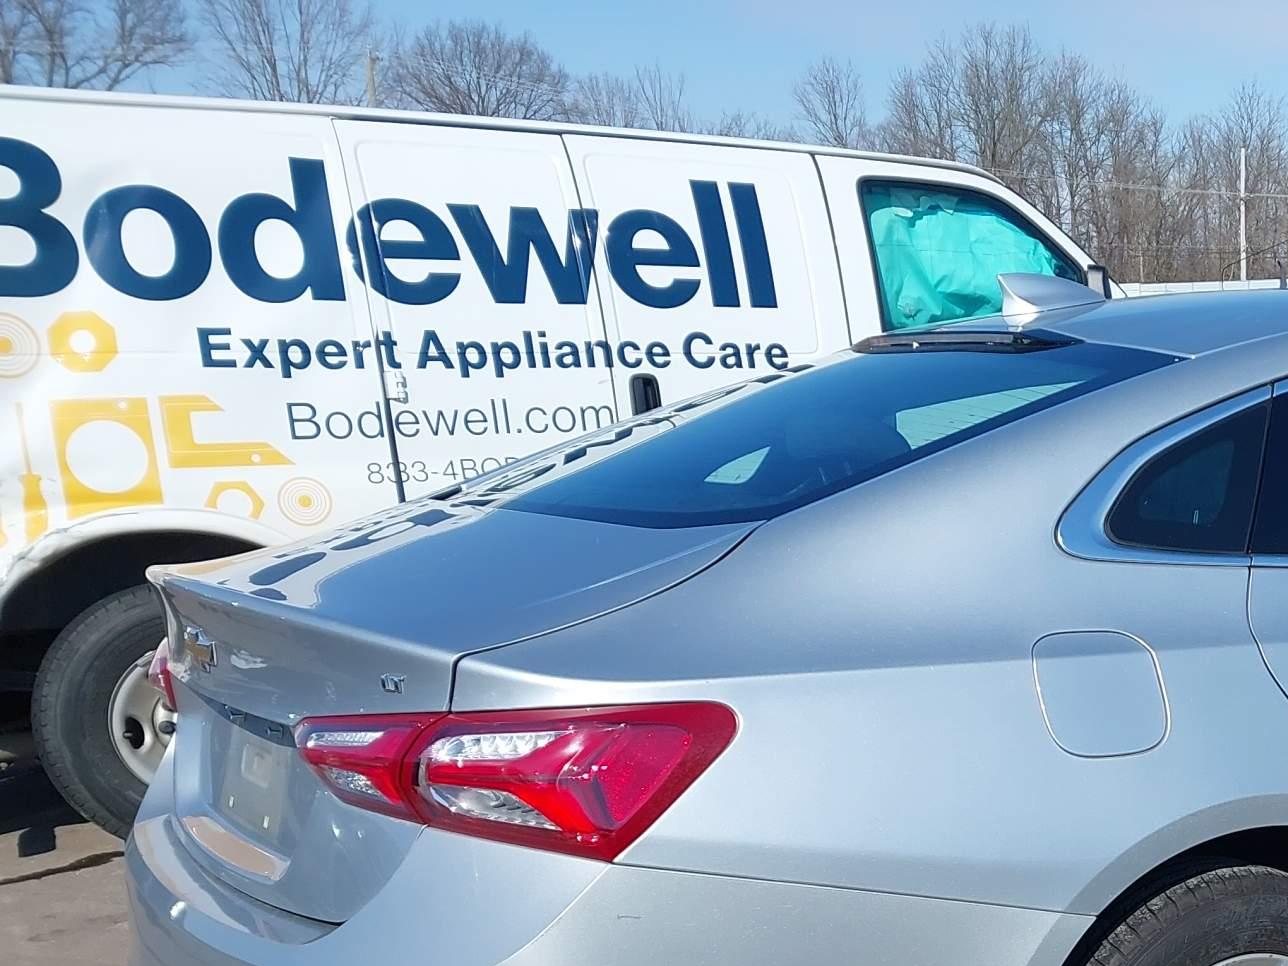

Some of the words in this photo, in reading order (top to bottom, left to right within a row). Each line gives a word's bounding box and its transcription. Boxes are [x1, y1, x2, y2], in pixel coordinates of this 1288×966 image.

[0, 136, 779, 309] Bodewell
[196, 326, 401, 379] Expert
[416, 329, 672, 379] Appliance
[682, 331, 790, 370] Care
[286, 397, 615, 441] Bodewell.com
